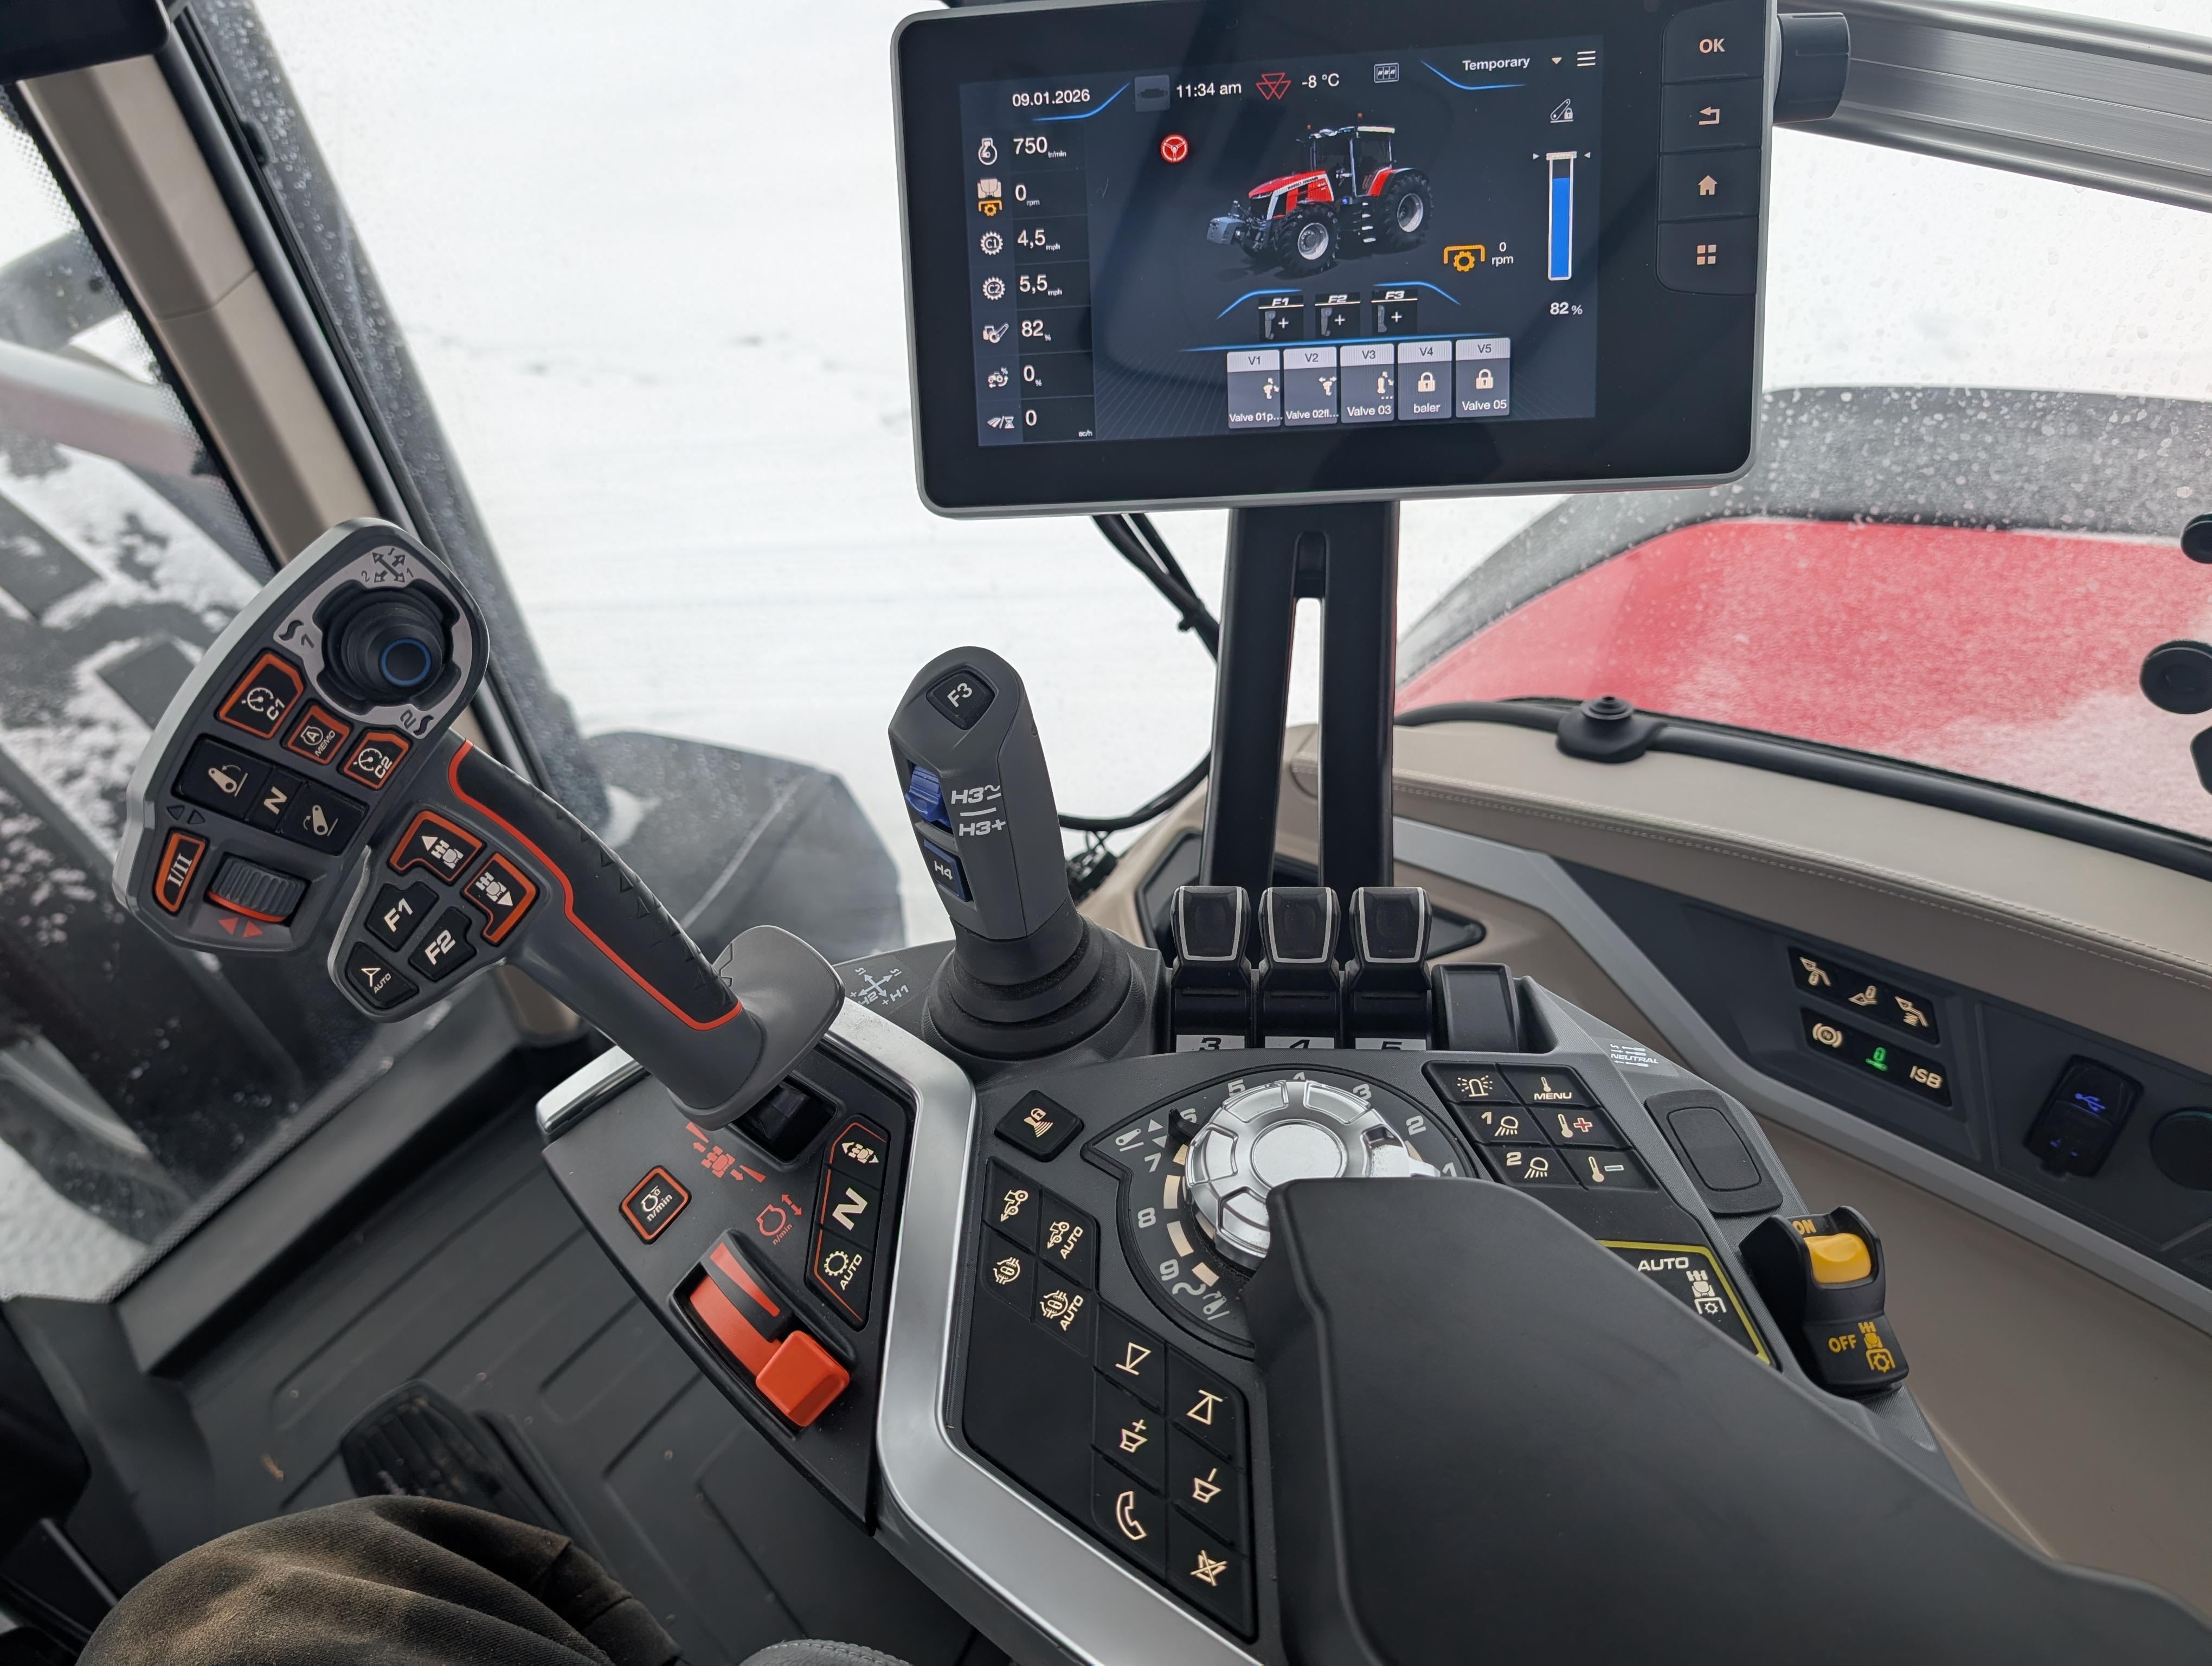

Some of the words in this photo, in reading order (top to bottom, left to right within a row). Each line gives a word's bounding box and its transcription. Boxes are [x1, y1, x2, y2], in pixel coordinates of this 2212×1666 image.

[1699, 38, 1725, 53] OK
[1462, 56, 1531, 72] Temporary
[1302, 75, 1317, 89] -8
[1322, 73, 1340, 87] °C
[1012, 89, 1090, 107] 09.01.2026
[1176, 84, 1216, 99] 11:34
[1219, 84, 1242, 95] am
[1013, 137, 1048, 155] 750
[1015, 184, 1027, 201] 0
[985, 239, 998, 248] C1
[1017, 228, 1046, 248] 4,5
[1045, 243, 1060, 251] mph
[1499, 241, 1507, 252] 0
[1491, 255, 1514, 267] rpm
[987, 284, 1000, 294] C2
[1019, 274, 1048, 294] 5,5
[1047, 288, 1063, 297] mph
[1272, 297, 1290, 306] F1
[1328, 294, 1348, 303] F2
[1385, 291, 1405, 299] F3
[1549, 302, 1570, 315] 82
[1571, 304, 1583, 315] %
[1021, 319, 1044, 337] 82
[1361, 350, 1376, 359] V3
[1419, 347, 1434, 356] V4
[1477, 344, 1492, 353] V5
[1248, 356, 1261, 366] V1
[1304, 353, 1319, 362] V2
[1023, 364, 1035, 382] 0
[1347, 407, 1375, 416] Valve
[1378, 405, 1392, 415] 03
[1413, 403, 1441, 413] baler
[1462, 401, 1491, 411] Valve
[1493, 399, 1507, 409] 05
[1025, 409, 1037, 426] 0
[1229, 413, 1254, 422] Valve
[1285, 410, 1310, 420] Valve
[362, 571, 370, 582] 2
[947, 683, 973, 708] F3
[266, 699, 285, 721] C1
[400, 709, 417, 730] 2
[308, 731, 320, 742] A
[314, 730, 336, 757] MEMO
[374, 756, 393, 779] C2
[263, 786, 287, 815] N
[167, 853, 192, 887] I/II
[934, 861, 953, 880] H4
[384, 898, 413, 932] F1
[425, 930, 456, 965] F2
[374, 973, 391, 994] AUTO
[890, 984, 909, 1001] H1
[1199, 1037, 1221, 1050] 3
[1610, 1053, 1658, 1063] NEUTRAL
[1909, 1066, 1943, 1089] ISB
[1227, 1079, 1245, 1097] 5
[1353, 1084, 1371, 1100] 3
[1534, 1092, 1572, 1100] MENU
[1179, 1108, 1197, 1124] 6
[1481, 1112, 1493, 1125] 1
[1406, 1116, 1427, 1136] 2
[1144, 1152, 1161, 1172] 7
[1506, 1151, 1521, 1166] 2
[646, 1193, 673, 1223] n/min
[832, 1187, 868, 1231] N
[1137, 1207, 1156, 1228] 8
[773, 1223, 793, 1245] n/min
[1792, 1219, 1817, 1235] ON
[1062, 1226, 1083, 1260] AUTO
[840, 1254, 863, 1290] AUTO
[1160, 1259, 1179, 1280] 9
[1637, 1257, 1689, 1272] AUTO
[1060, 1295, 1084, 1331] AUTO
[1829, 1334, 1857, 1353] OFF
